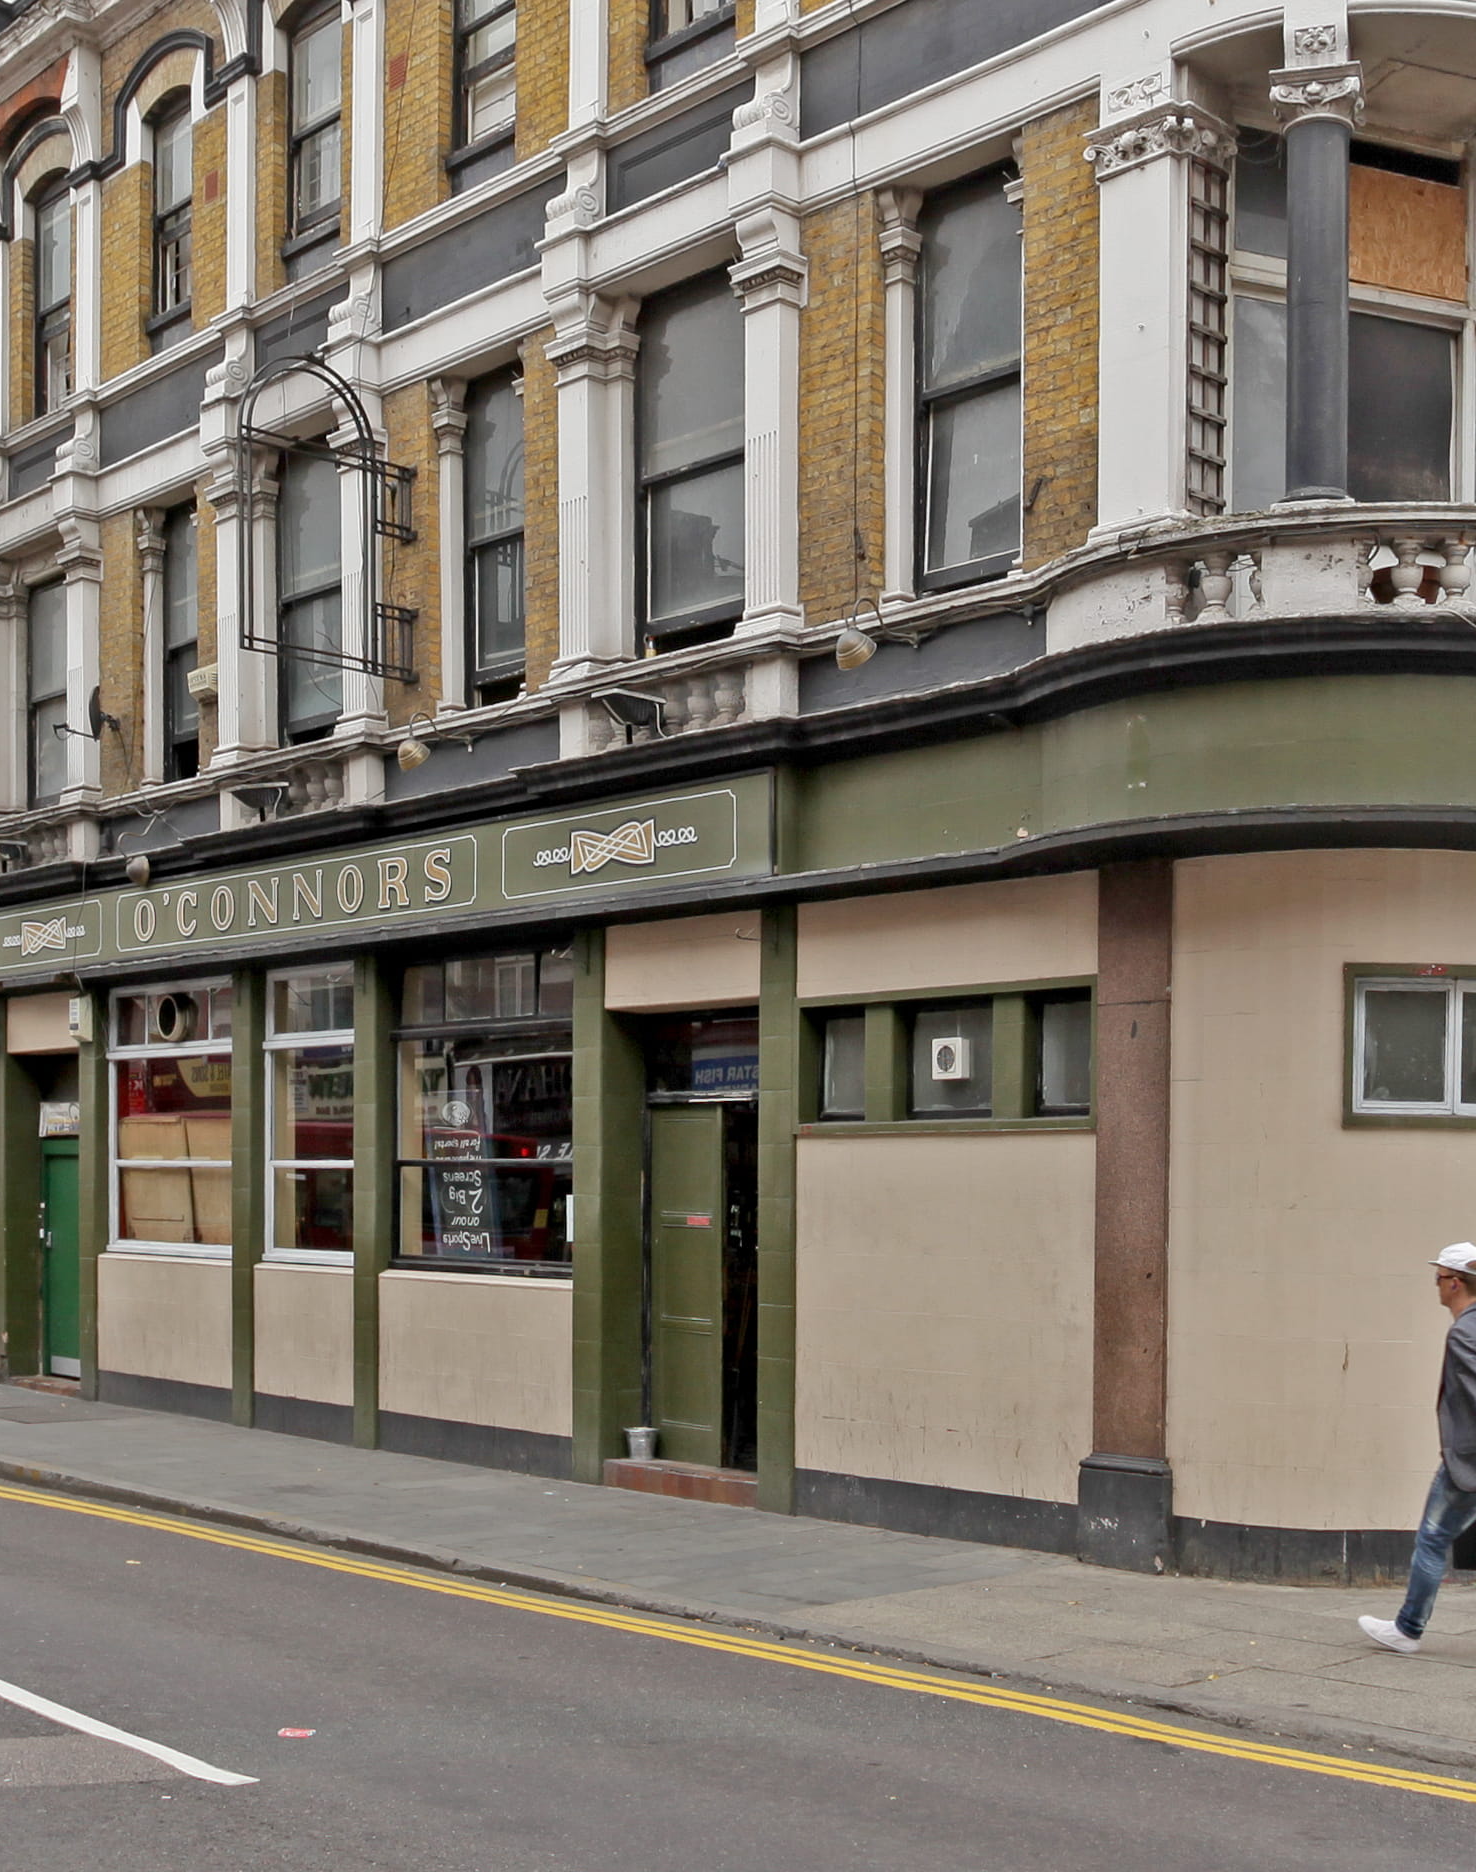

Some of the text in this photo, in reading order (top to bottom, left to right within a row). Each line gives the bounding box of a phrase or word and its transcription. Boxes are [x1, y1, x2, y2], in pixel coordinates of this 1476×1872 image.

[134, 848, 452, 942] O'CONNORS
[443, 1170, 482, 1187] Screens
[449, 1186, 483, 1214] 2 Big
